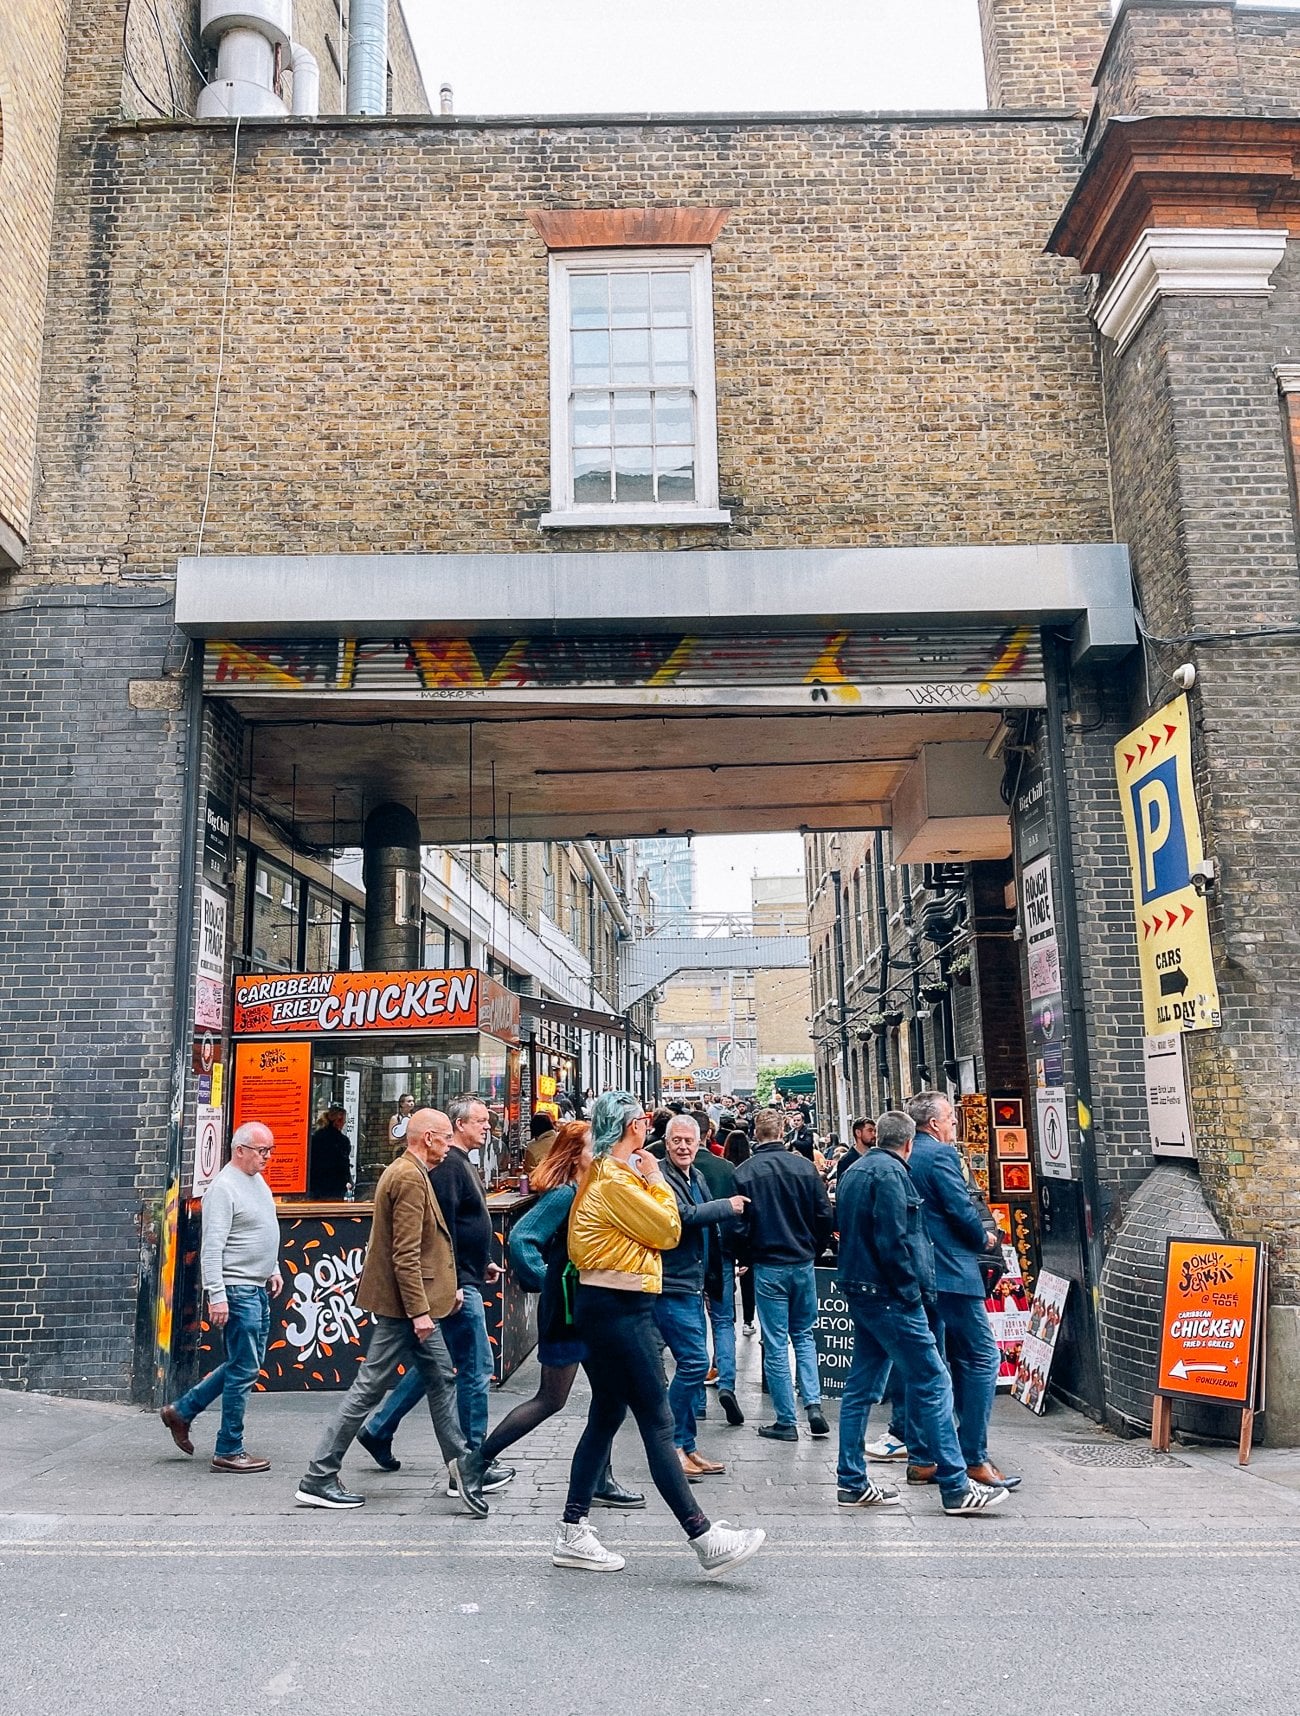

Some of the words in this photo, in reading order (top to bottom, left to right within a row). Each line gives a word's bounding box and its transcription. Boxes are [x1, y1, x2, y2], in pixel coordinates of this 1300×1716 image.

[1139, 779, 1171, 893] P
[1025, 867, 1049, 903] ROUGH
[1155, 948, 1182, 970] CARS
[237, 975, 334, 1004] CARIBBEAN
[272, 999, 321, 1020] FRIED
[317, 974, 476, 1030] CHICKEN
[1157, 1005, 1171, 1024] ALL
[1173, 1000, 1196, 1020] DAY
[314, 1250, 364, 1288] ONL
[1190, 1252, 1219, 1268] ONLY
[1212, 1293, 1239, 1301] CAFÉ
[1178, 1310, 1213, 1319] CARIBBEAN
[1170, 1319, 1245, 1339] CHICKEN
[823, 1335, 855, 1350] THIS
[1183, 1340, 1201, 1349] FRIED
[1207, 1341, 1235, 1350] GRILLED
[817, 1353, 853, 1368] POIN
